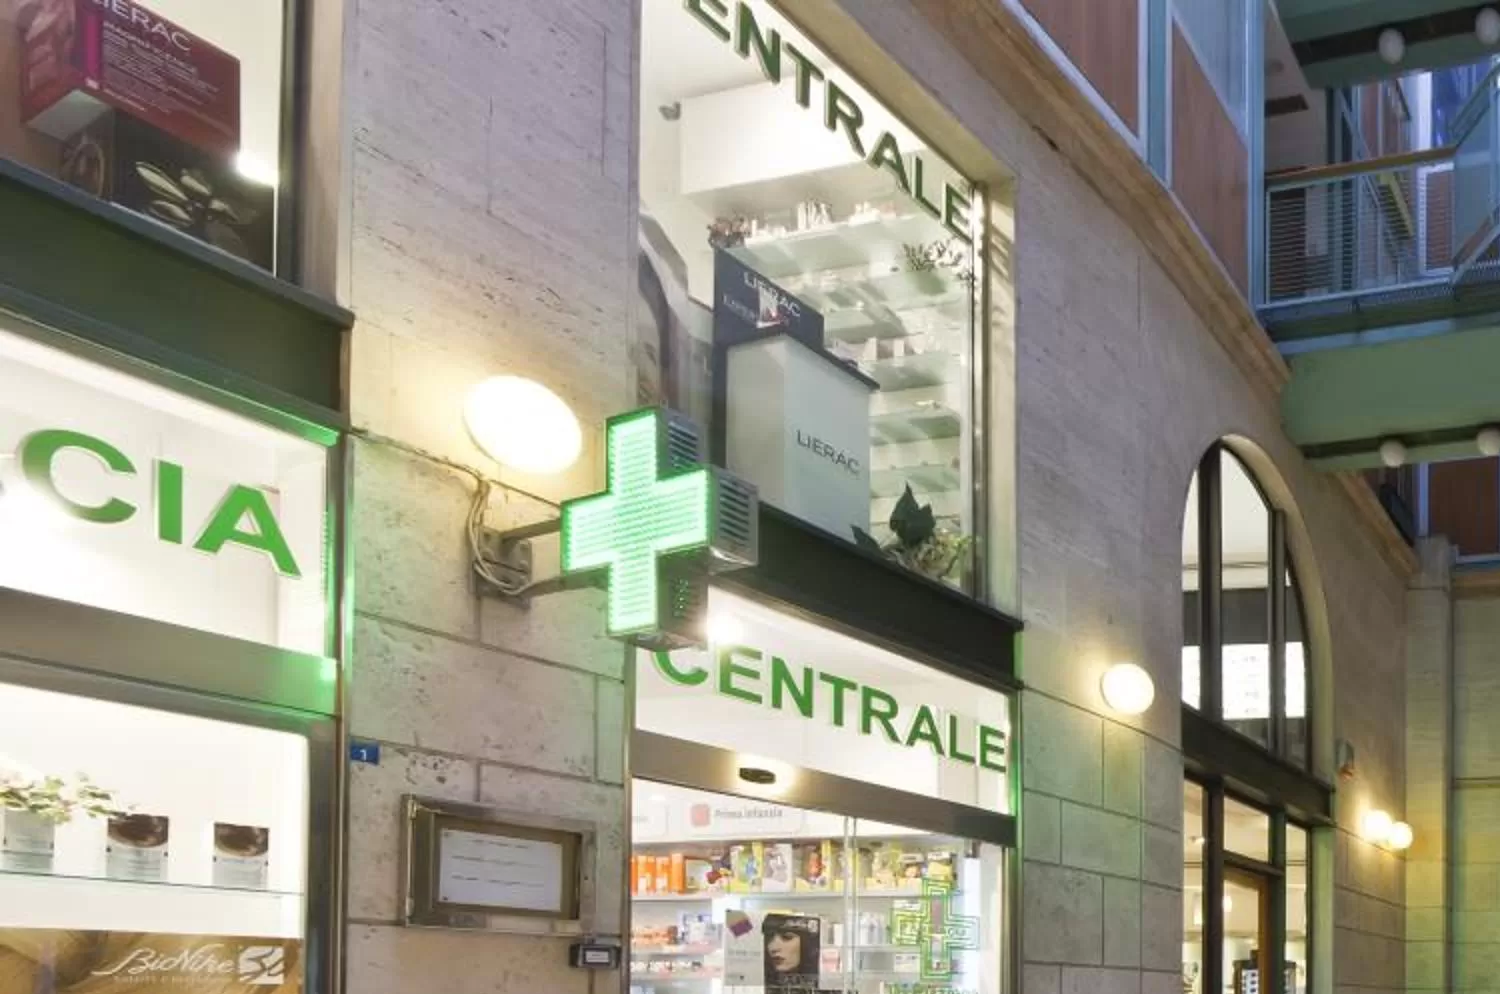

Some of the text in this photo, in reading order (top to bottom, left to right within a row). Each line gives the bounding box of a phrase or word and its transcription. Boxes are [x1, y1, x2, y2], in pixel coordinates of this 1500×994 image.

[94, 0, 191, 51] ERAC
[796, 429, 861, 476] LIERAC
[652, 645, 1007, 773] CENTRALE
